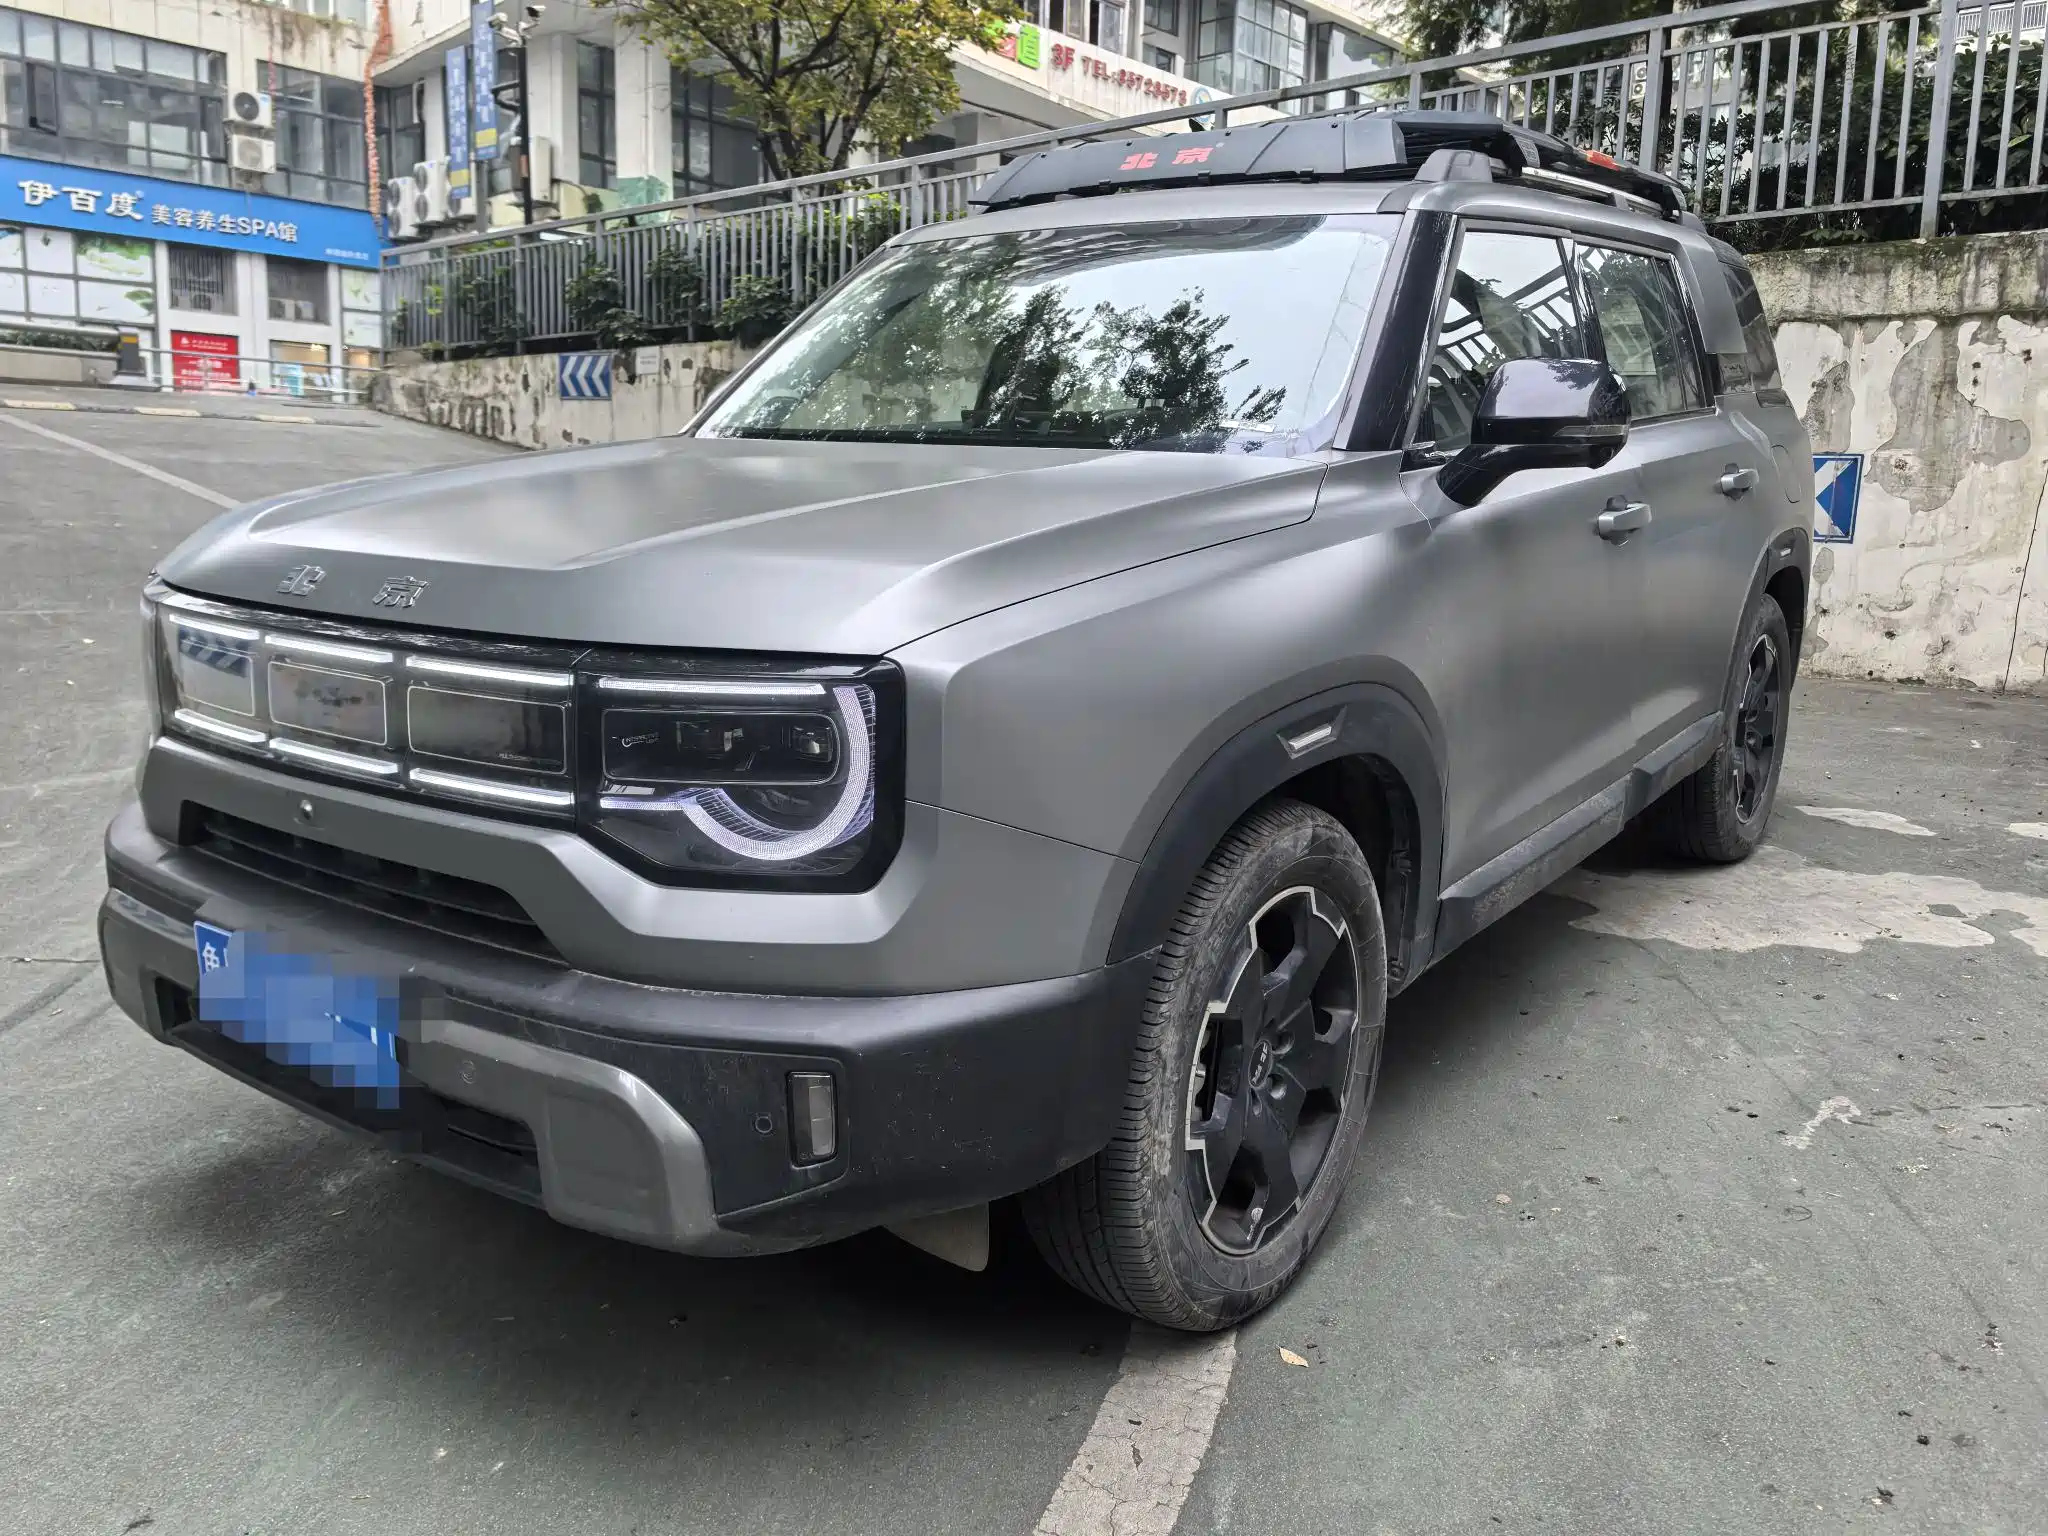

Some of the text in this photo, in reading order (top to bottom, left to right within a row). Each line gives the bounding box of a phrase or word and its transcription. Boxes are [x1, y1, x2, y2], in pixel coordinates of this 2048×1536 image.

[1051, 43, 1075, 71] 3F
[1119, 147, 1214, 170] 北京
[17, 180, 144, 221] 伊百度
[151, 203, 298, 243] 美容养生SPA馆
[275, 564, 428, 608] 北京
